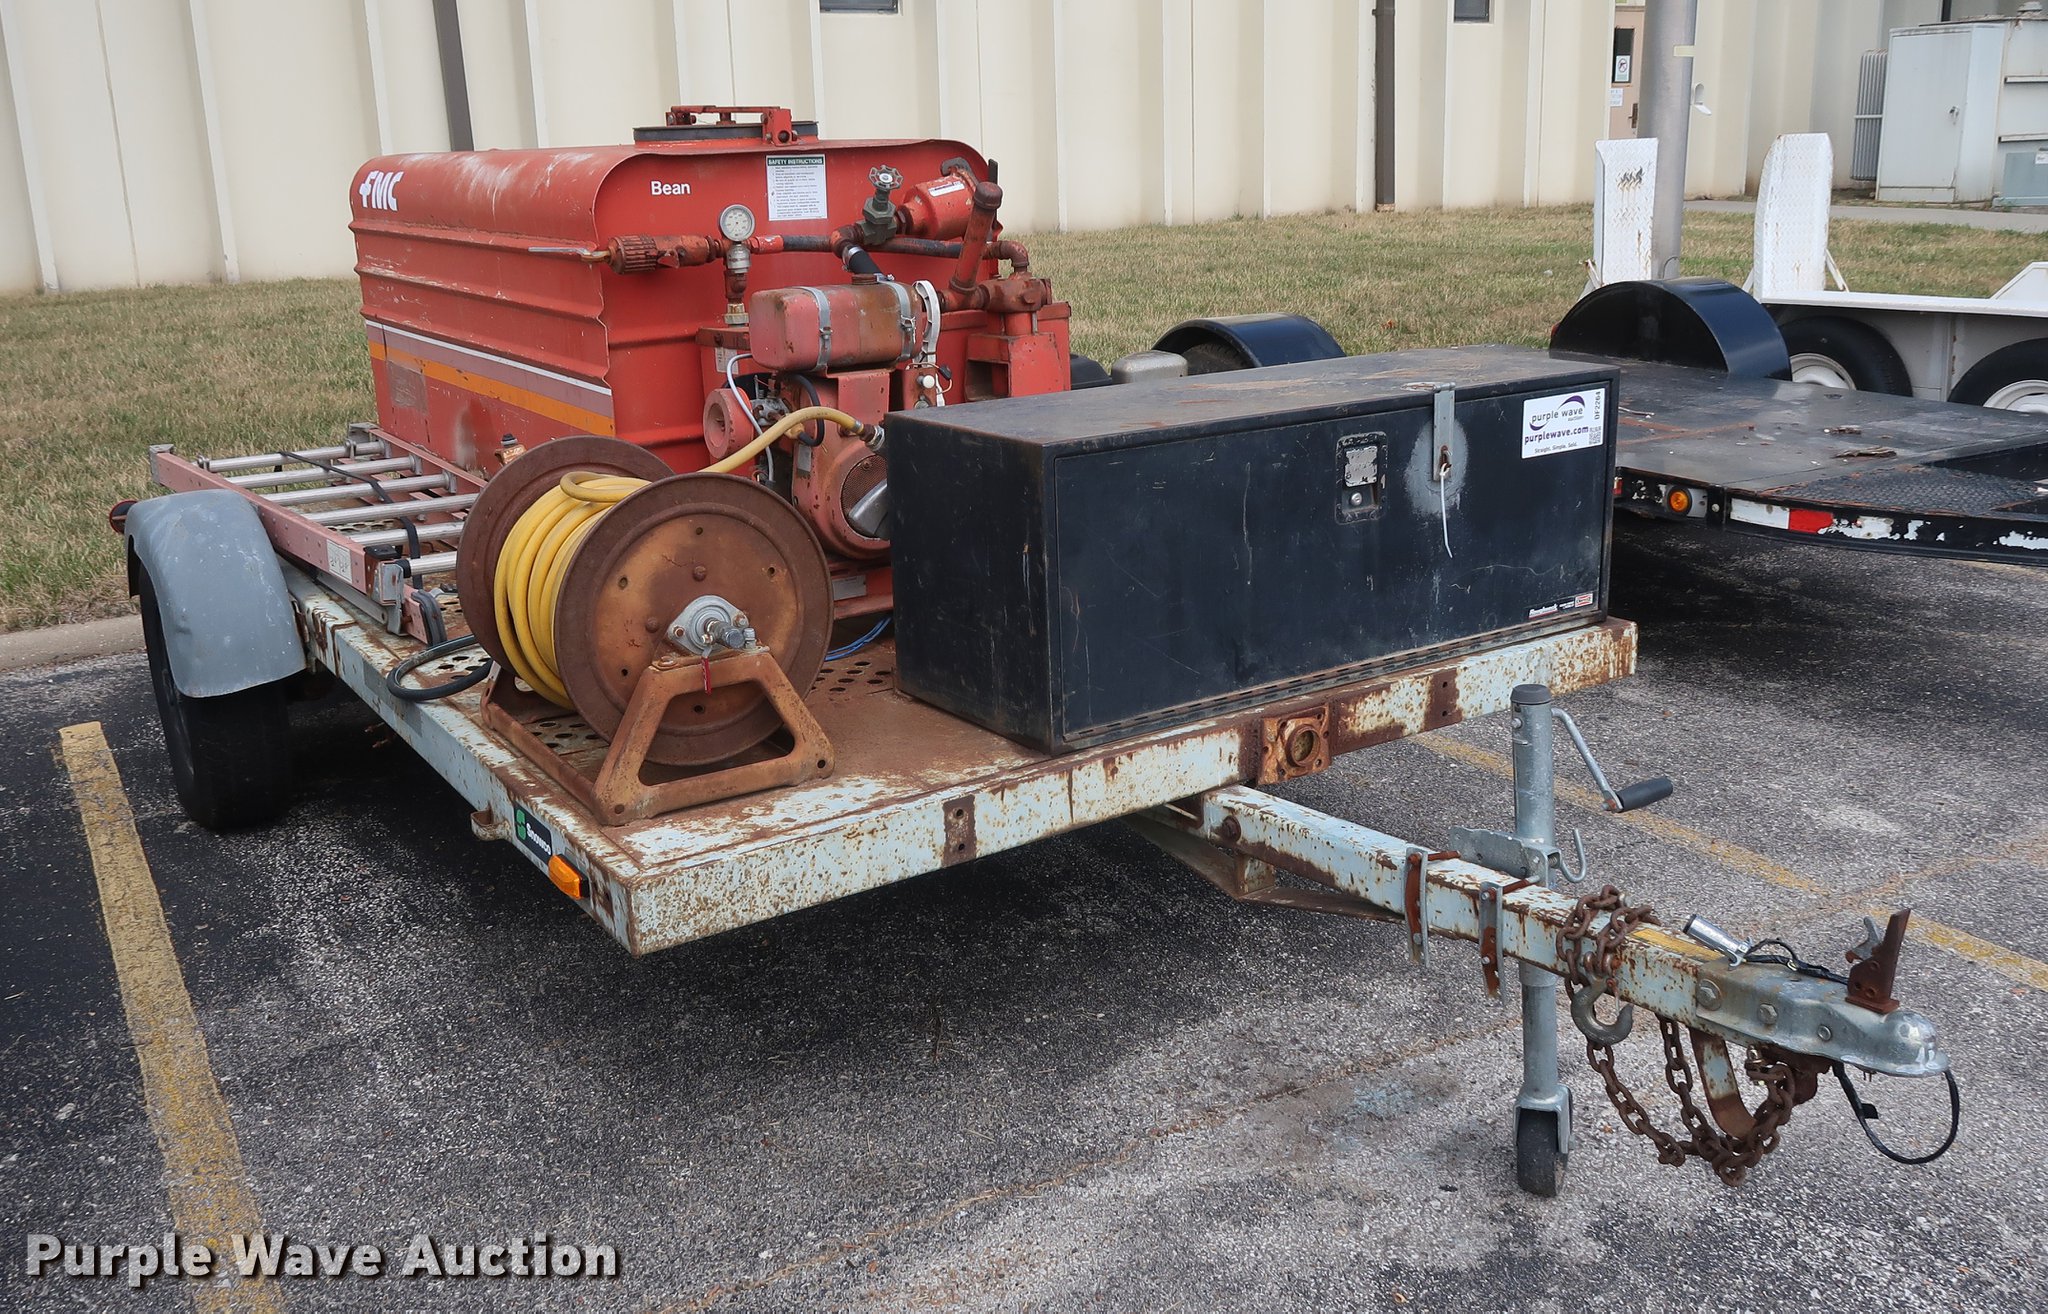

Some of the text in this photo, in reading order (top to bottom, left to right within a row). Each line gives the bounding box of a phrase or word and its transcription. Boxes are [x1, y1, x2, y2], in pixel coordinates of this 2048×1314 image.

[359, 170, 404, 211] FMC
[651, 180, 691, 195] Bean
[1531, 410, 1559, 423] purple
[1562, 407, 1583, 417] wave
[1525, 426, 1588, 445] purplewave.com
